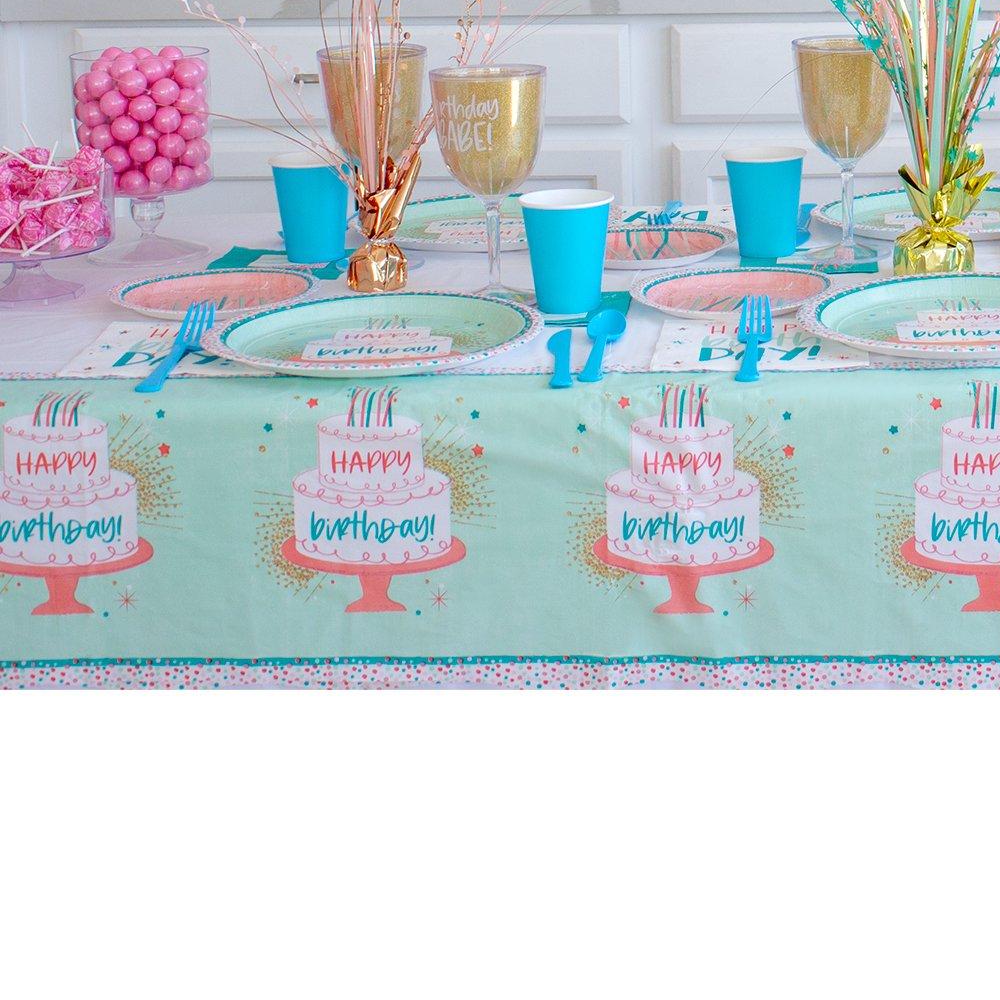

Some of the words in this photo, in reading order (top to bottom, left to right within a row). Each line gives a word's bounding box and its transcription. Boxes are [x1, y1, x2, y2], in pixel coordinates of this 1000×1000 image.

[16, 451, 97, 477] HAPPY
[331, 450, 412, 476] HAPPY
[643, 451, 722, 477] HAPPY
